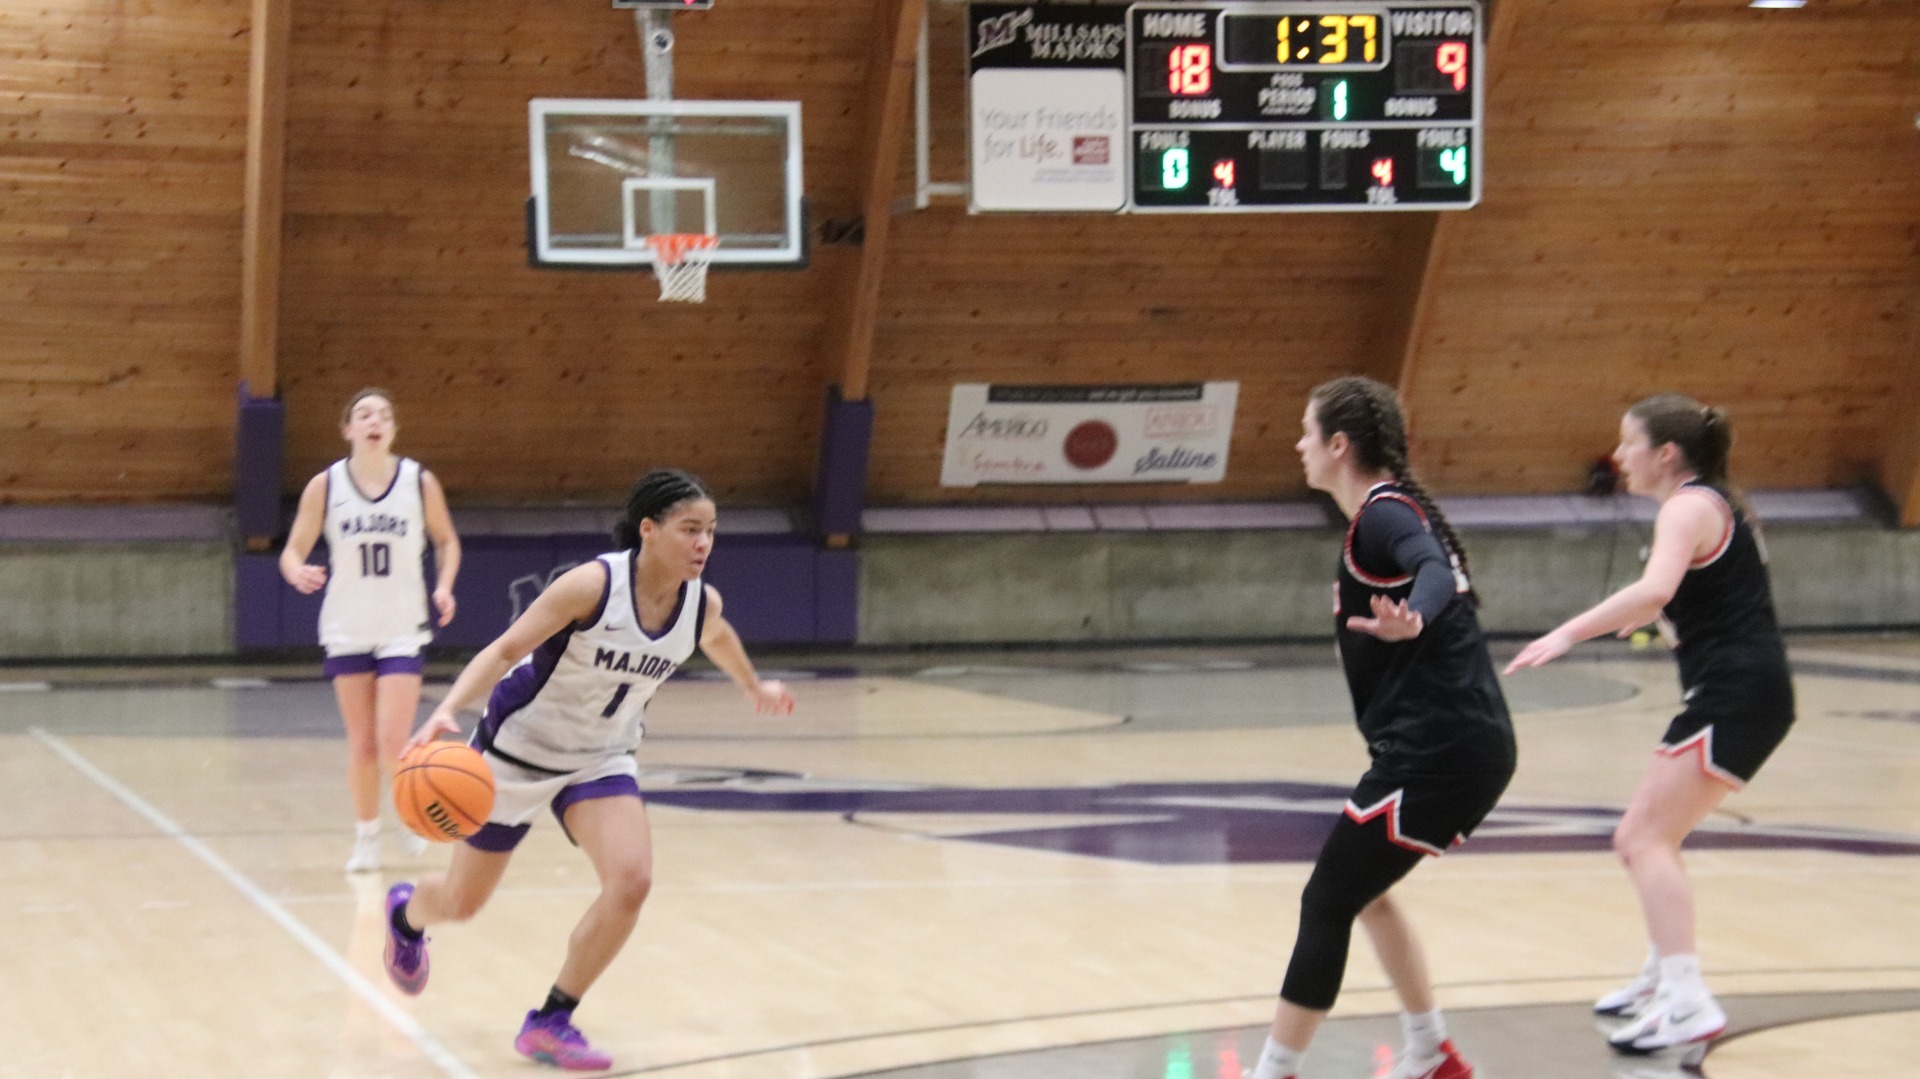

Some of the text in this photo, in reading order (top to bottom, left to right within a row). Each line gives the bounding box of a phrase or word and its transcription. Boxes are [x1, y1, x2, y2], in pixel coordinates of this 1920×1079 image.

[1025, 23, 1125, 44] MILLSAPS
[1143, 13, 1206, 37] HOME
[1391, 11, 1472, 36] VISITOR
[1031, 42, 1120, 61] MAJORS
[1277, 15, 1376, 64] 1:37
[1169, 45, 1211, 94] 18
[1436, 42, 1467, 91] 9
[1169, 99, 1222, 119] BONUS
[1258, 88, 1317, 108] PERIOD
[1333, 80, 1347, 120] 1
[1384, 97, 1438, 117] BONUS
[979, 107, 1119, 130] Your Friends
[983, 132, 1015, 164] for
[1140, 131, 1190, 149] FOULS
[1248, 130, 1306, 149] PLAYER
[1320, 129, 1370, 148] FOULS
[1416, 129, 1467, 147] FOULS
[1162, 147, 1189, 189] 0
[1213, 160, 1235, 188] 4
[1371, 158, 1393, 186] 4
[1439, 146, 1466, 184] 4
[1133, 447, 1217, 475] Saltine
[341, 513, 408, 538] MAJORS
[358, 543, 390, 577] 10
[600, 682, 632, 718] 1
